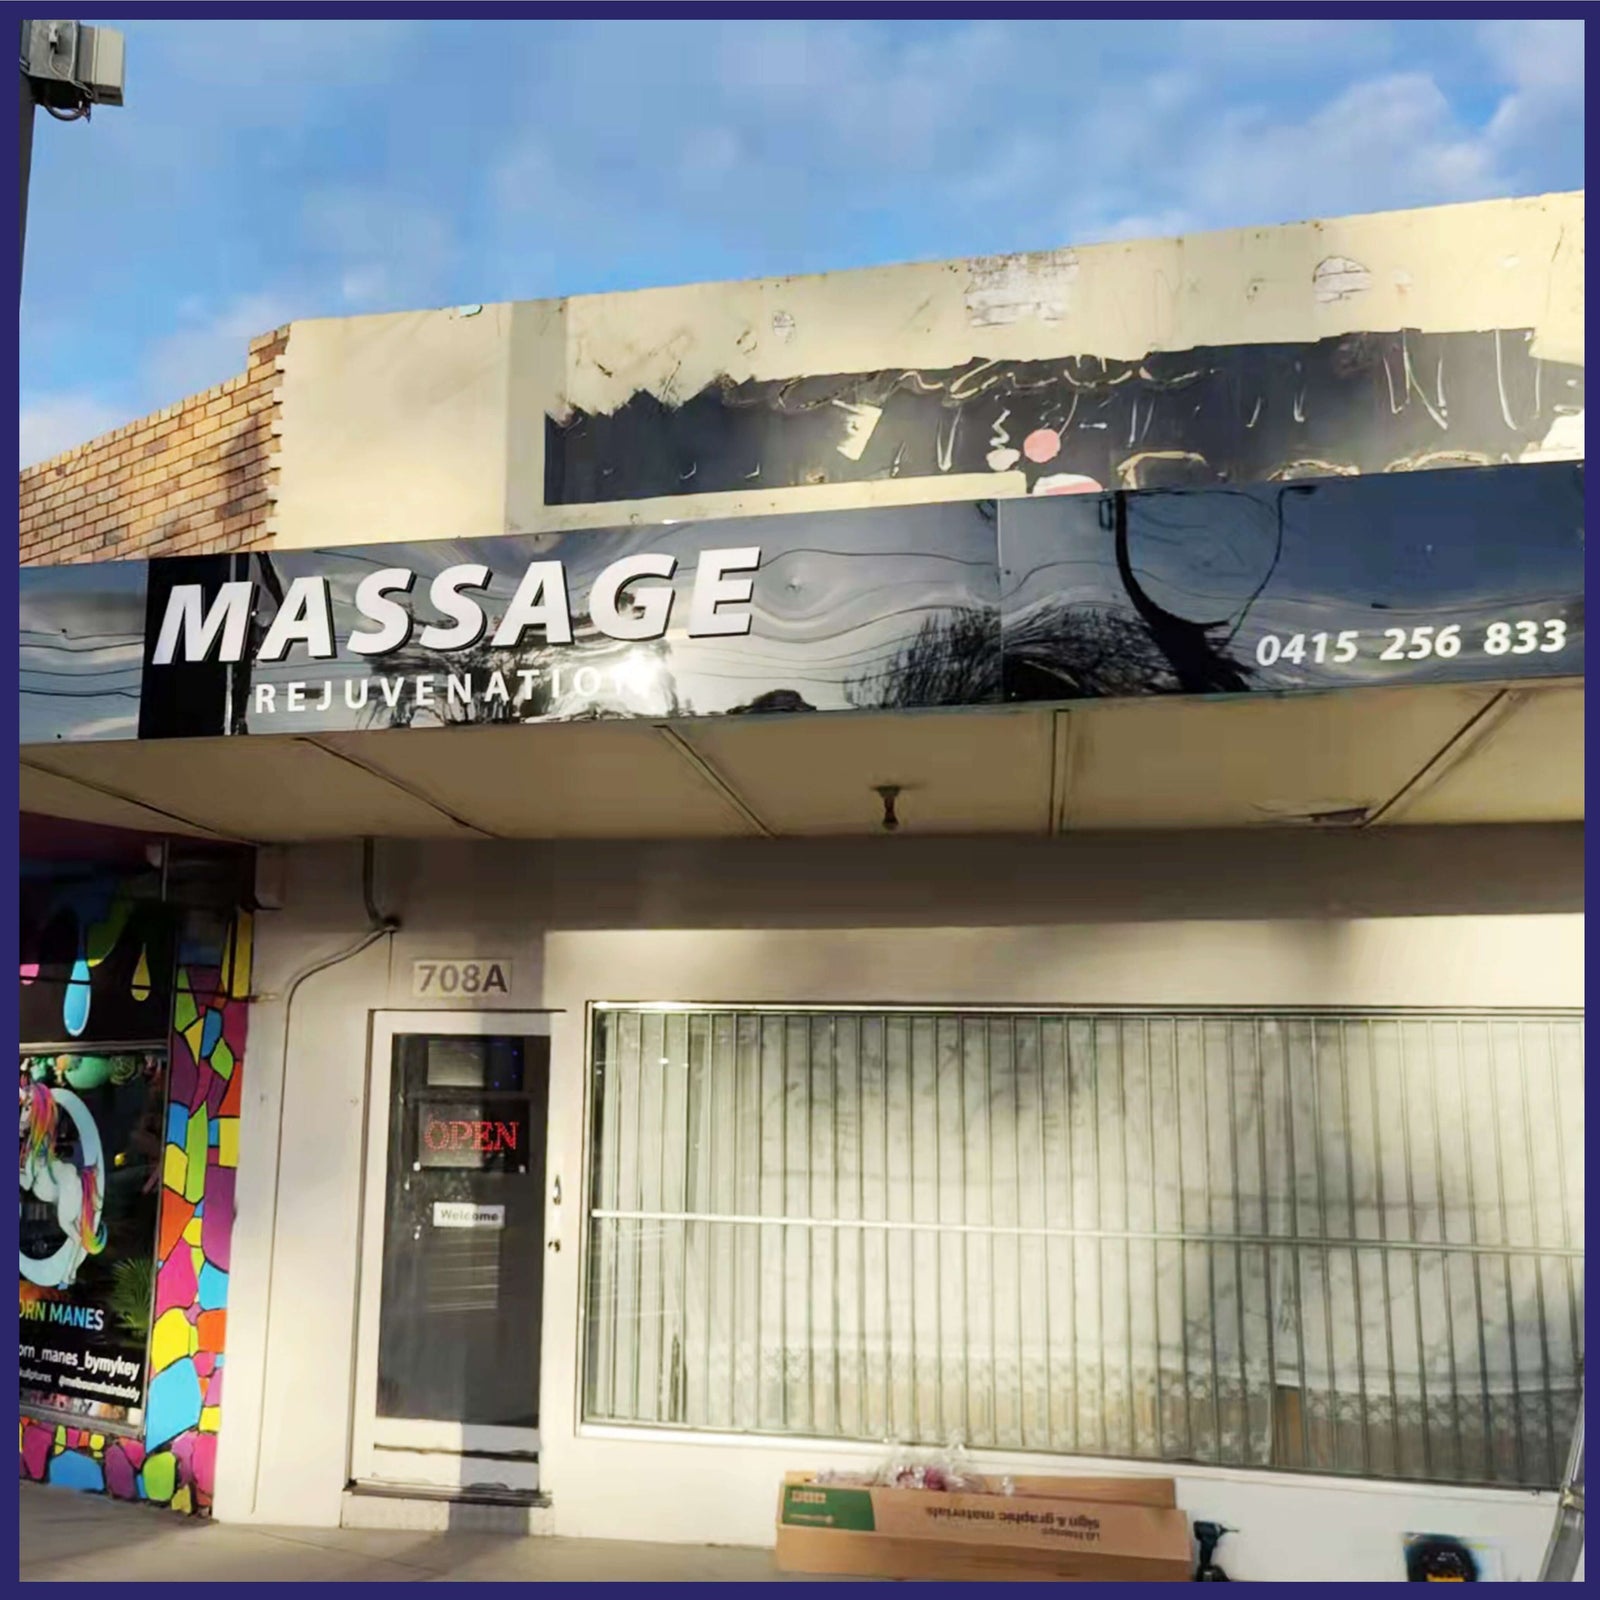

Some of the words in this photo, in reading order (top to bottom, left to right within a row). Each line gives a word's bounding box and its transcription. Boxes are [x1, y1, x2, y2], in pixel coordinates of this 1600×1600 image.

[152, 546, 762, 664] MASSAGE
[1255, 630, 1359, 667] 0415
[1379, 624, 1462, 661] 256
[1482, 619, 1568, 656] 833
[418, 963, 508, 994] 708A
[423, 1120, 520, 1152] OPEN
[440, 1208, 499, 1223] Welcome
[49, 1302, 105, 1331] MANES
[925, 1506, 996, 1520] materials
[998, 1511, 1055, 1526] graphic
[1068, 1514, 1101, 1529] sign
